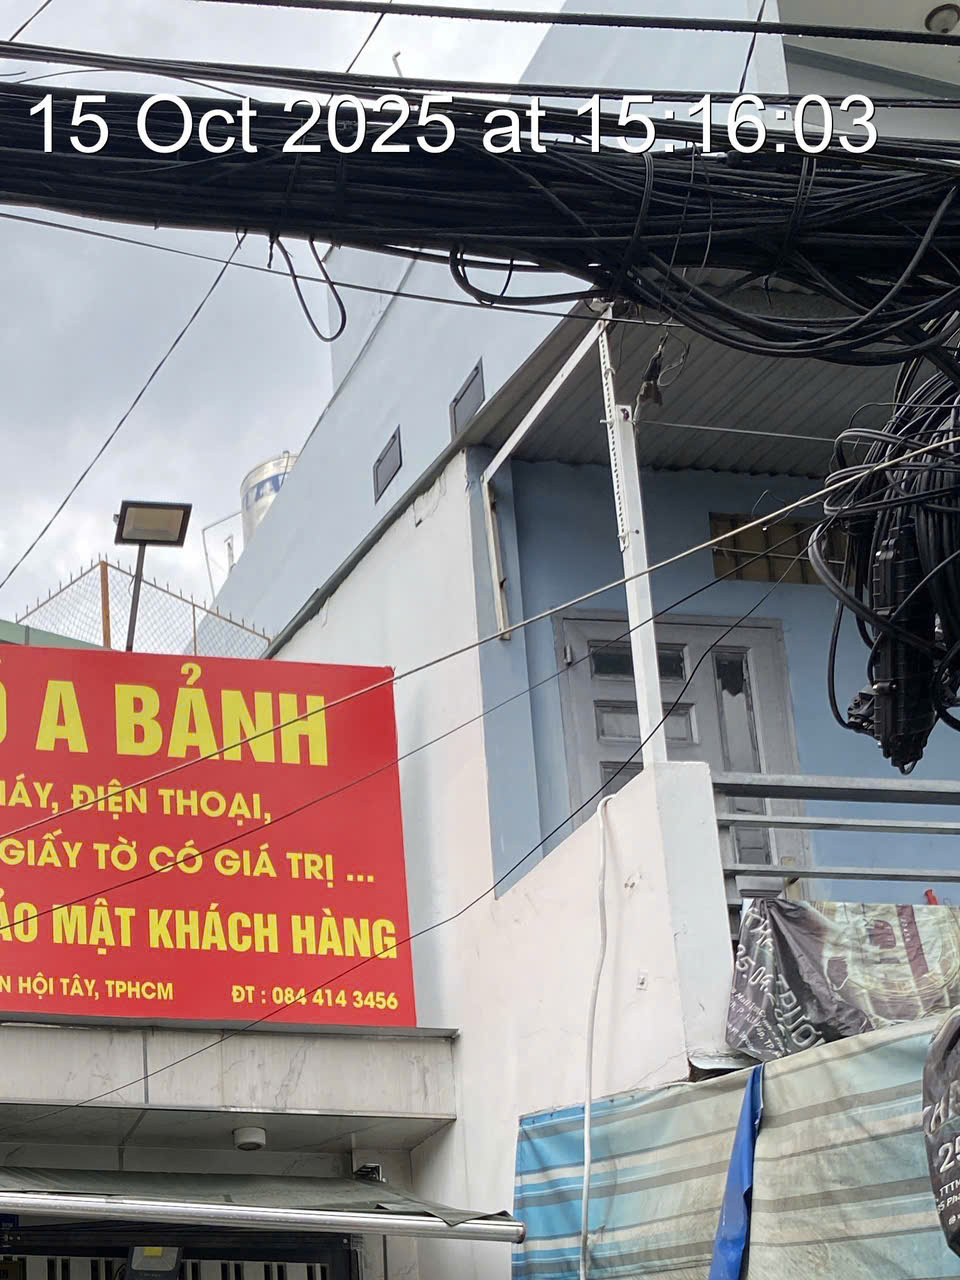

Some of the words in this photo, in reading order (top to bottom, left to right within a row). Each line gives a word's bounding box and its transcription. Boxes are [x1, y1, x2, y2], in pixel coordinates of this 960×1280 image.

[36, 680, 88, 753] A
[115, 662, 328, 767] BẢNH
[71, 779, 147, 820] ĐIỆN
[159, 788, 272, 826] THOẠI,
[0, 829, 83, 868] GIẤY
[93, 836, 138, 871] TỜ
[149, 840, 202, 874] CÓ
[214, 843, 276, 878] GIÁ
[287, 852, 334, 888] TRỊ
[52, 898, 135, 955] MẬT
[148, 904, 279, 953] KHÁCH
[291, 908, 398, 959] HÀNG
[18, 971, 54, 1000] HỘI
[60, 975, 100, 1000] TÂY,
[105, 979, 173, 1001] TPHCM
[231, 985, 255, 1004] ĐT
[272, 986, 306, 1006] 084
[312, 988, 347, 1007] 414
[353, 990, 398, 1010] 3456
